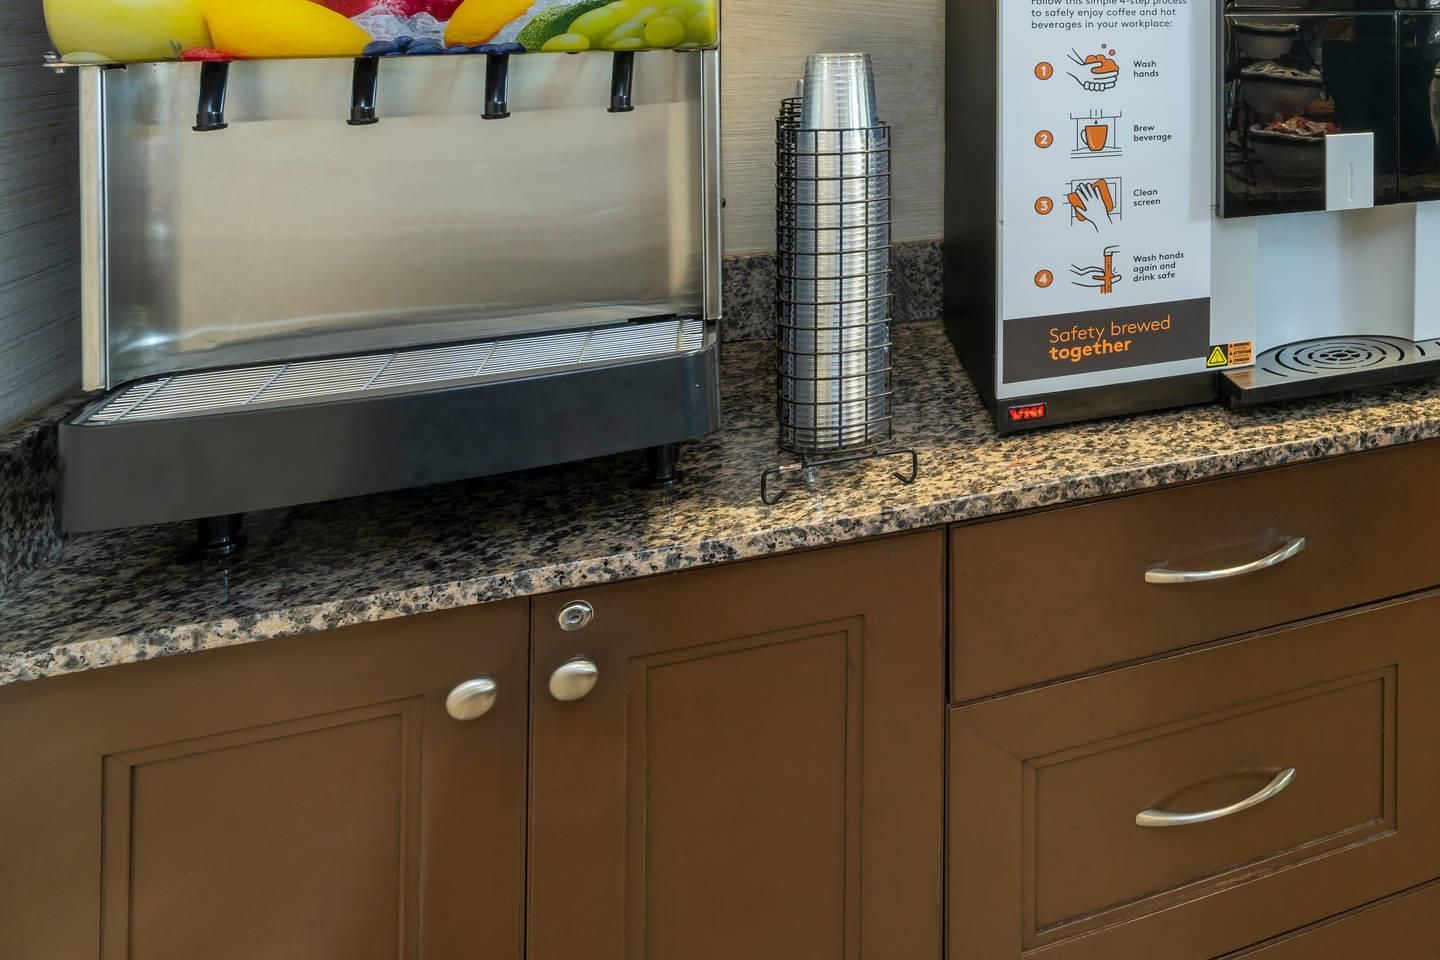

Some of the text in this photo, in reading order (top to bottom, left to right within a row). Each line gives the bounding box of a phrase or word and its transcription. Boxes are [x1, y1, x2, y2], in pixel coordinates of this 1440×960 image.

[1031, 7, 1176, 19] to safely enjoy coffee and hot
[1031, 19, 1173, 31] beverages in your workplace:
[1132, 60, 1157, 69] Wash
[1132, 70, 1160, 79] hands
[1132, 124, 1155, 133] Brew
[1039, 134, 1049, 145] 2
[1132, 133, 1173, 143] beverage
[1132, 188, 1159, 198] Clean
[1039, 200, 1049, 212] 3
[1132, 198, 1161, 207] screen
[1132, 251, 1185, 264] Wash hands
[1132, 261, 1176, 275] again and
[1038, 272, 1048, 284] 4
[1132, 271, 1176, 283] drink safe
[1048, 313, 1172, 344] Safety brewed
[1048, 338, 1132, 363] together
